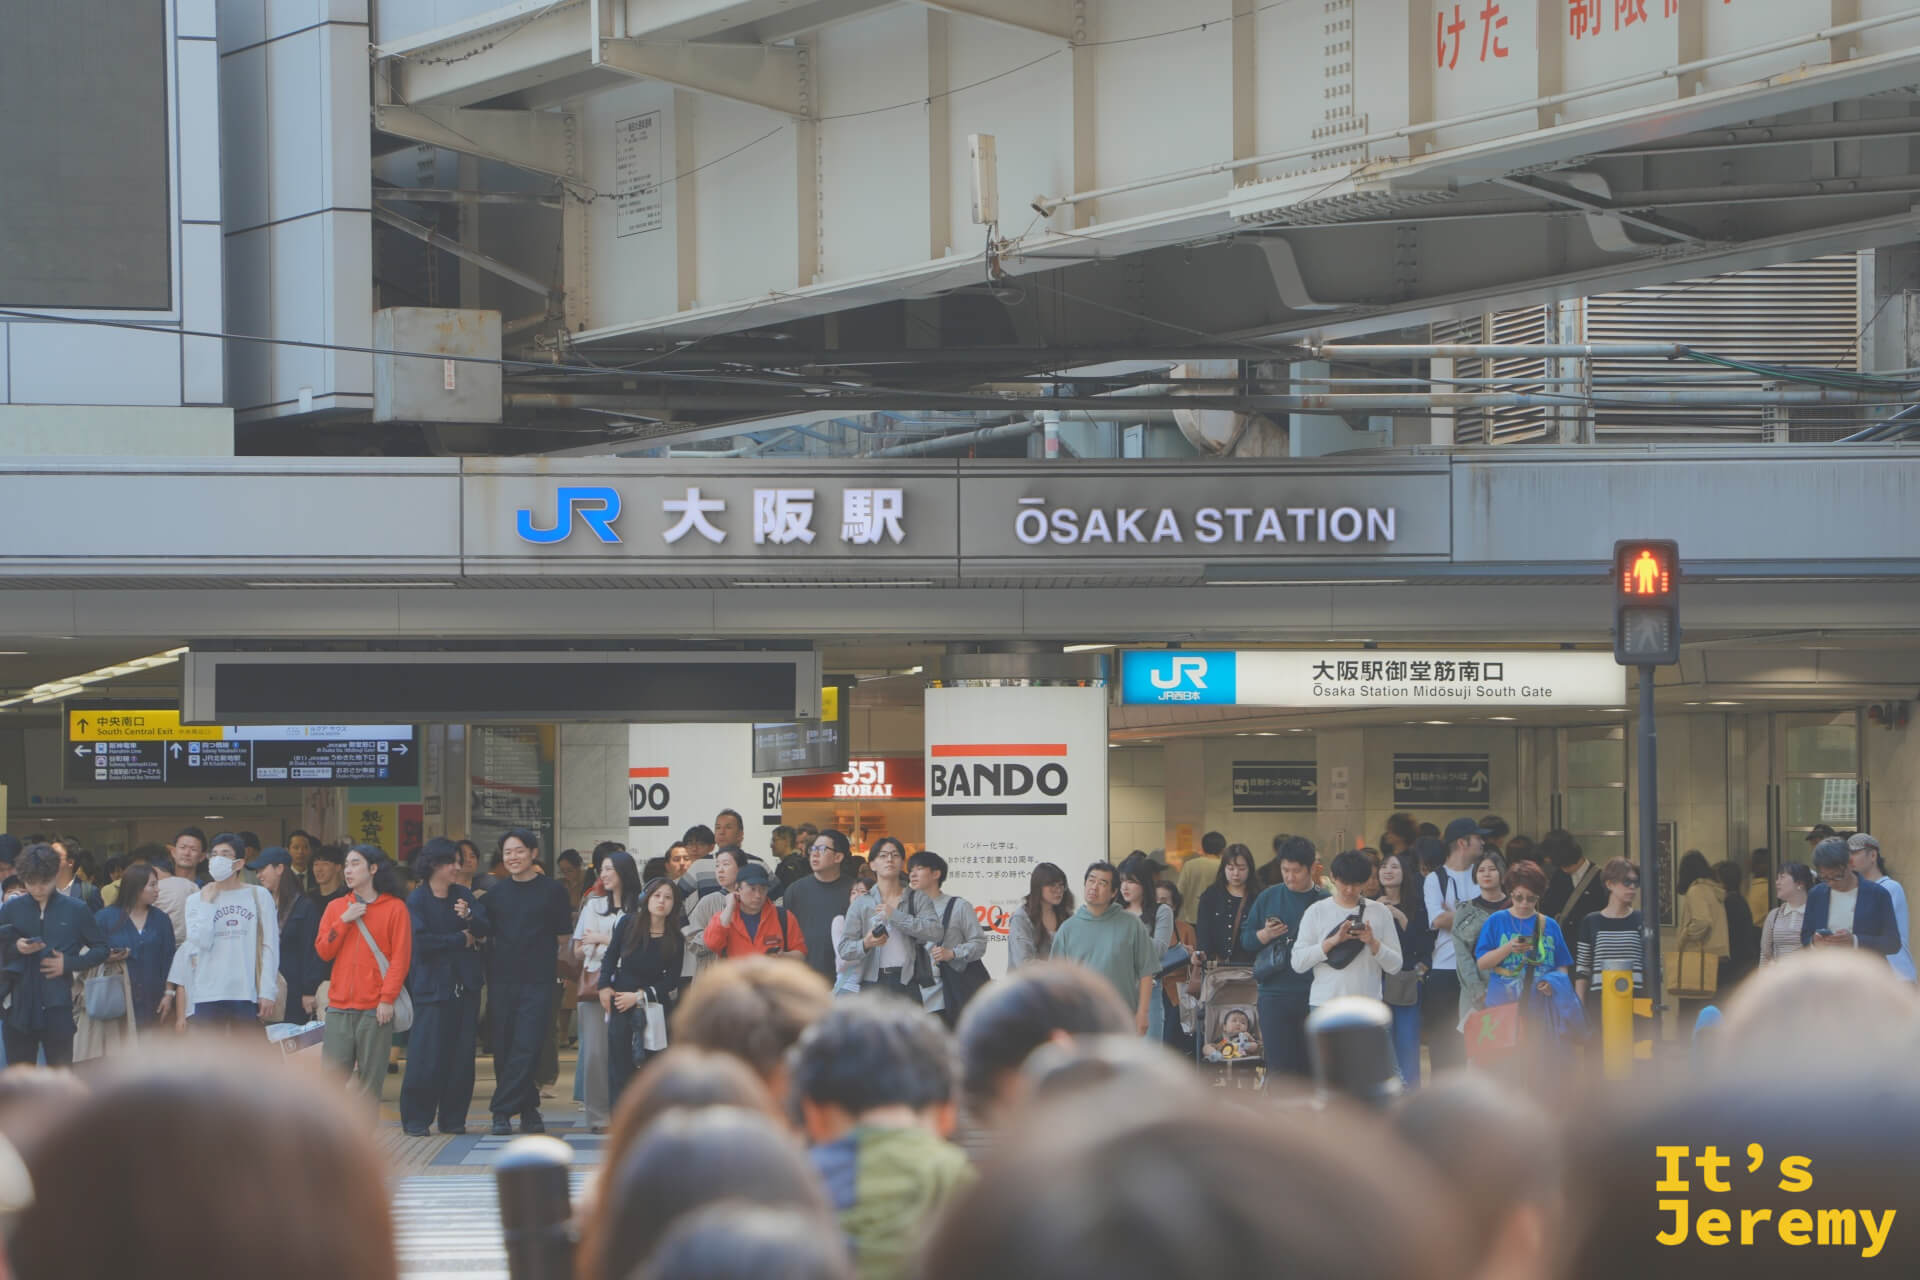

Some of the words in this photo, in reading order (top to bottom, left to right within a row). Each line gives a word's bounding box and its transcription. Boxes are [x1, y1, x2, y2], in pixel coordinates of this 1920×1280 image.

[516, 487, 624, 544] JR
[662, 486, 906, 544] 大阪駅
[1015, 497, 1184, 544] ŌSAKA
[1195, 507, 1396, 544] STATION
[1151, 656, 1208, 689] JR
[1312, 660, 1504, 682] 大阪駅御堂筋南口
[1158, 691, 1201, 701] JR西日本
[1312, 683, 1356, 697] Ōsaka
[1360, 685, 1409, 697] Station
[1413, 685, 1472, 700] Midōsuji
[1476, 685, 1517, 697] South
[1521, 685, 1553, 697] Gate
[96, 716, 145, 727] 中央南口
[96, 728, 123, 736] South
[125, 727, 155, 737] Central
[157, 728, 174, 736] Exit
[841, 760, 885, 785] 551
[931, 762, 1068, 797] BANDO
[833, 784, 893, 797] HORAI
